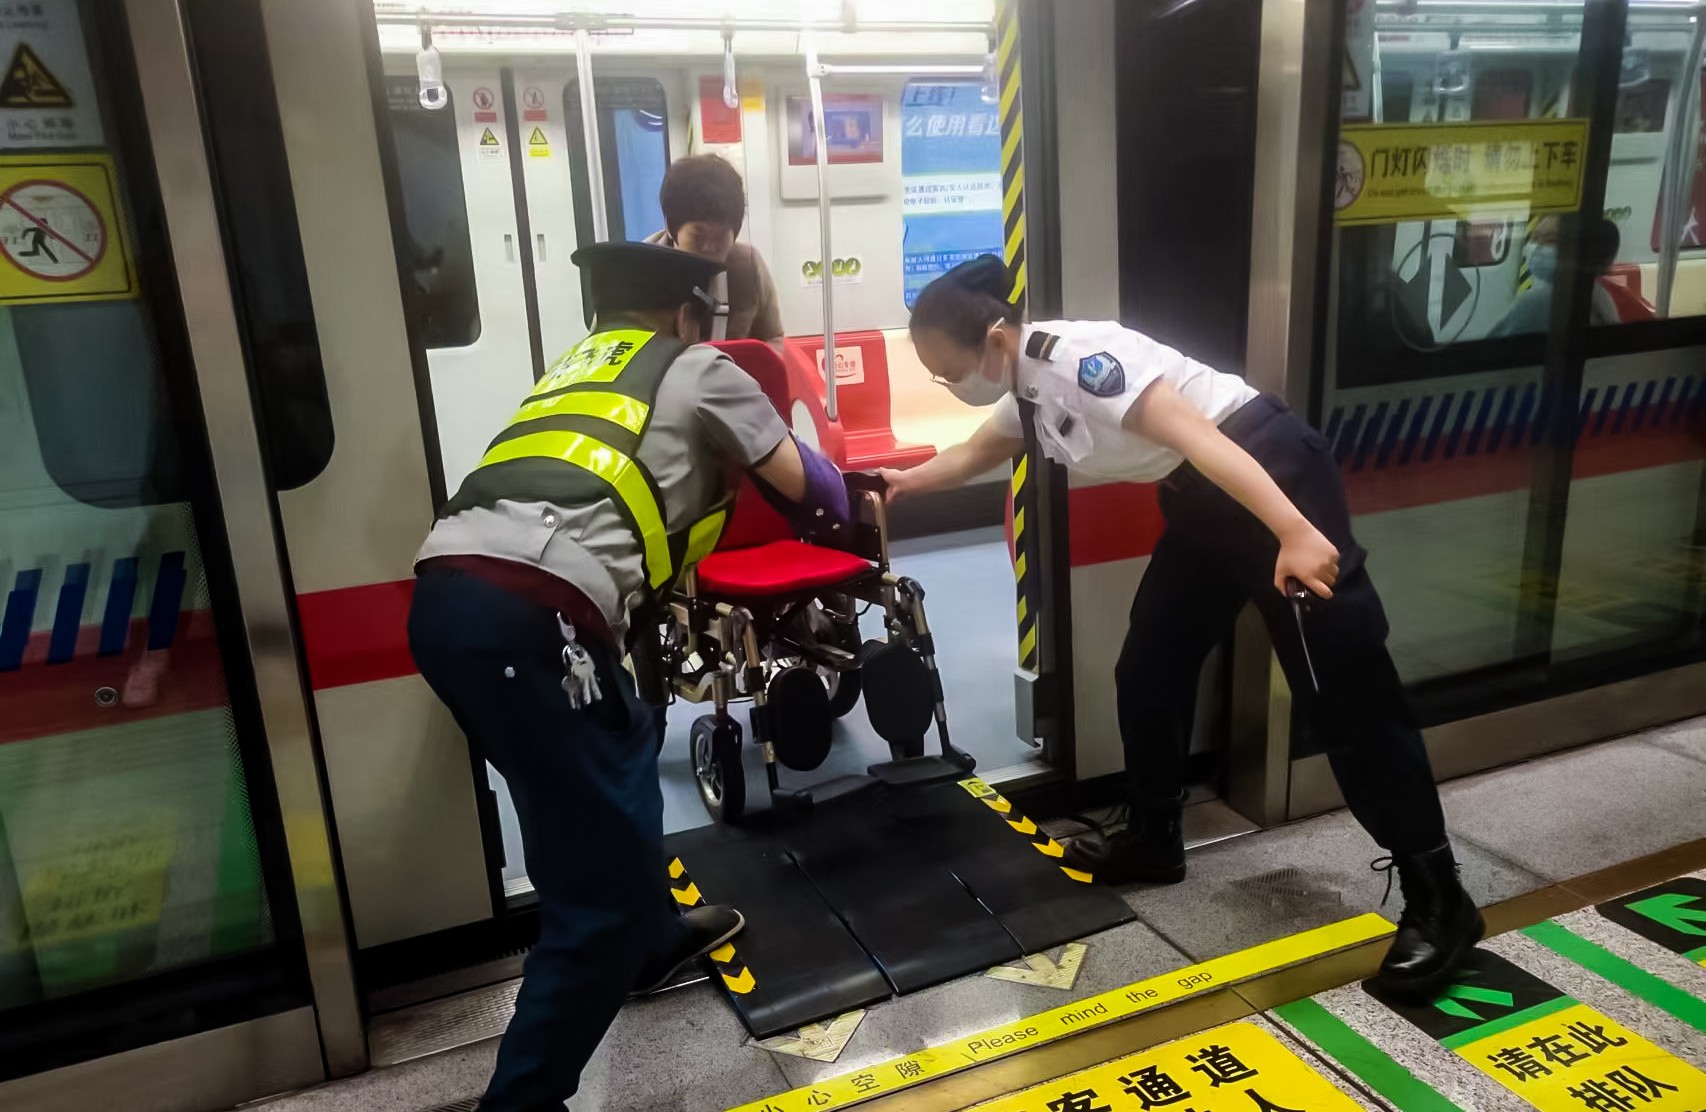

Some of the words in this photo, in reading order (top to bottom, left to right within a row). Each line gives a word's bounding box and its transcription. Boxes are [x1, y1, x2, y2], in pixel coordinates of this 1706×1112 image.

[967, 1025, 1039, 1055] Please
[1059, 1002, 1108, 1026] mind
[1125, 987, 1159, 1004] the
[1177, 970, 1213, 990] gap
[1486, 1021, 1629, 1083] 请在此
[1566, 1065, 1680, 1112] 排队
